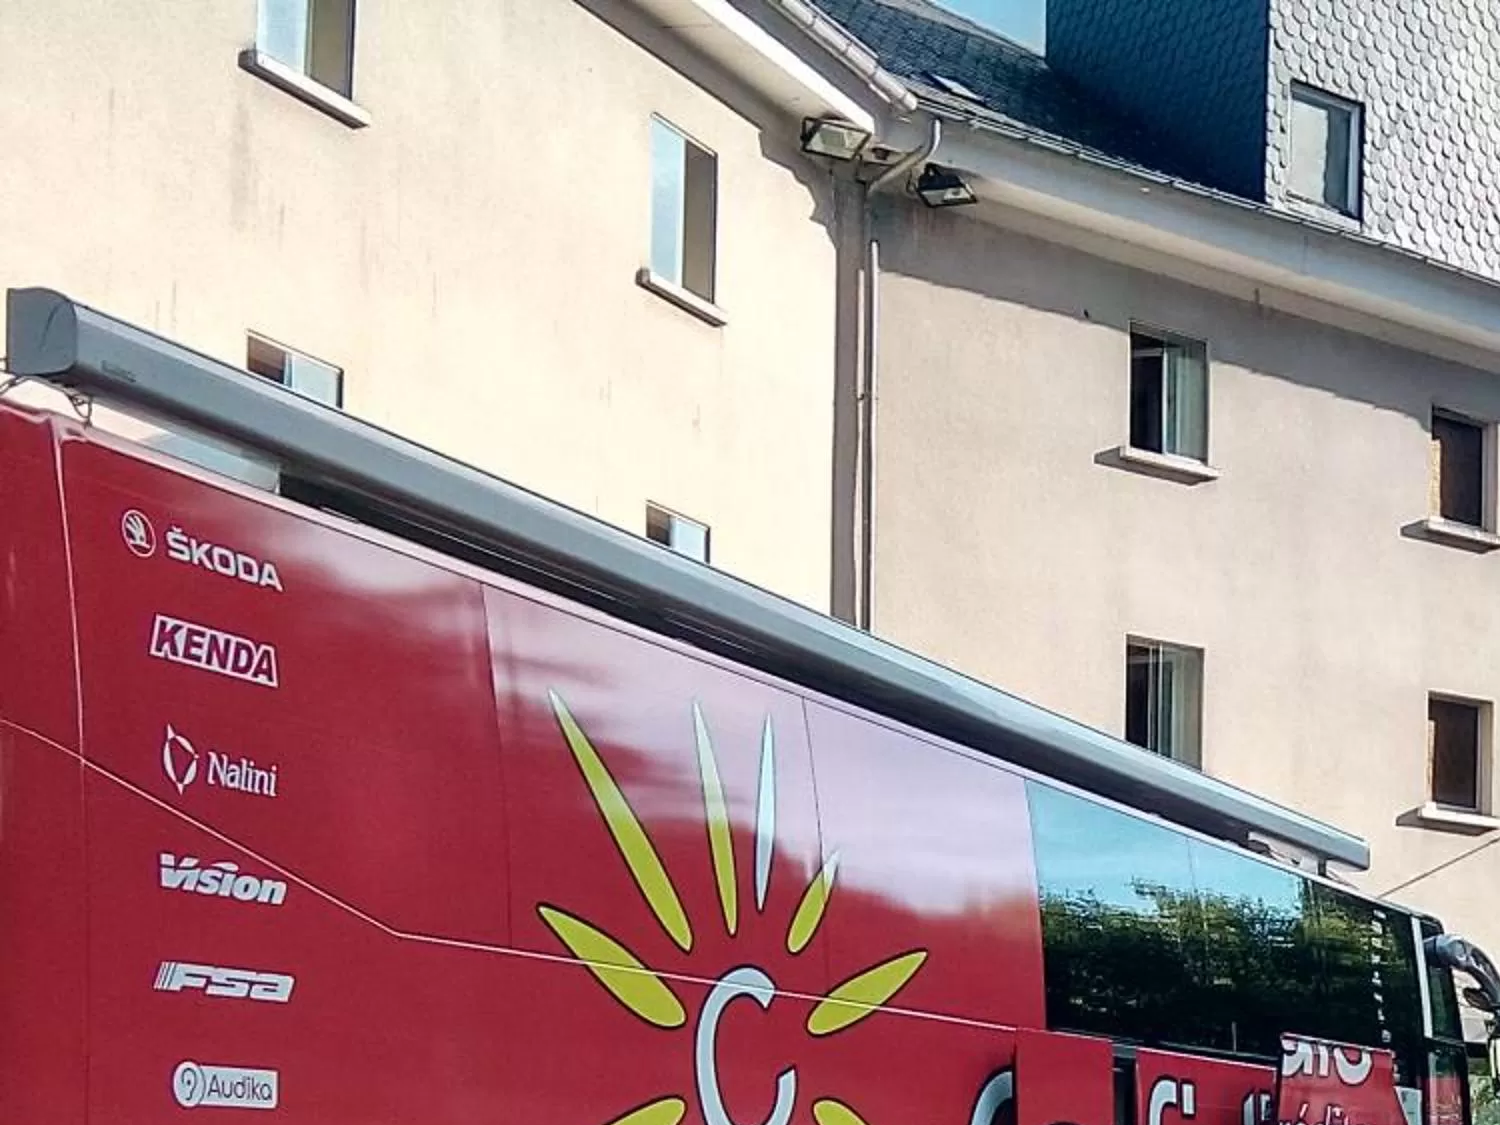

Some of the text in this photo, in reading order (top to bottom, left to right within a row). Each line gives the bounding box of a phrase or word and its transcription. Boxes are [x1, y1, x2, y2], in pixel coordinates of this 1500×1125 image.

[166, 527, 283, 592] ŠKODA
[154, 618, 277, 684] KENDA
[207, 751, 277, 797] Nalini
[206, 1075, 273, 1102] Audika
